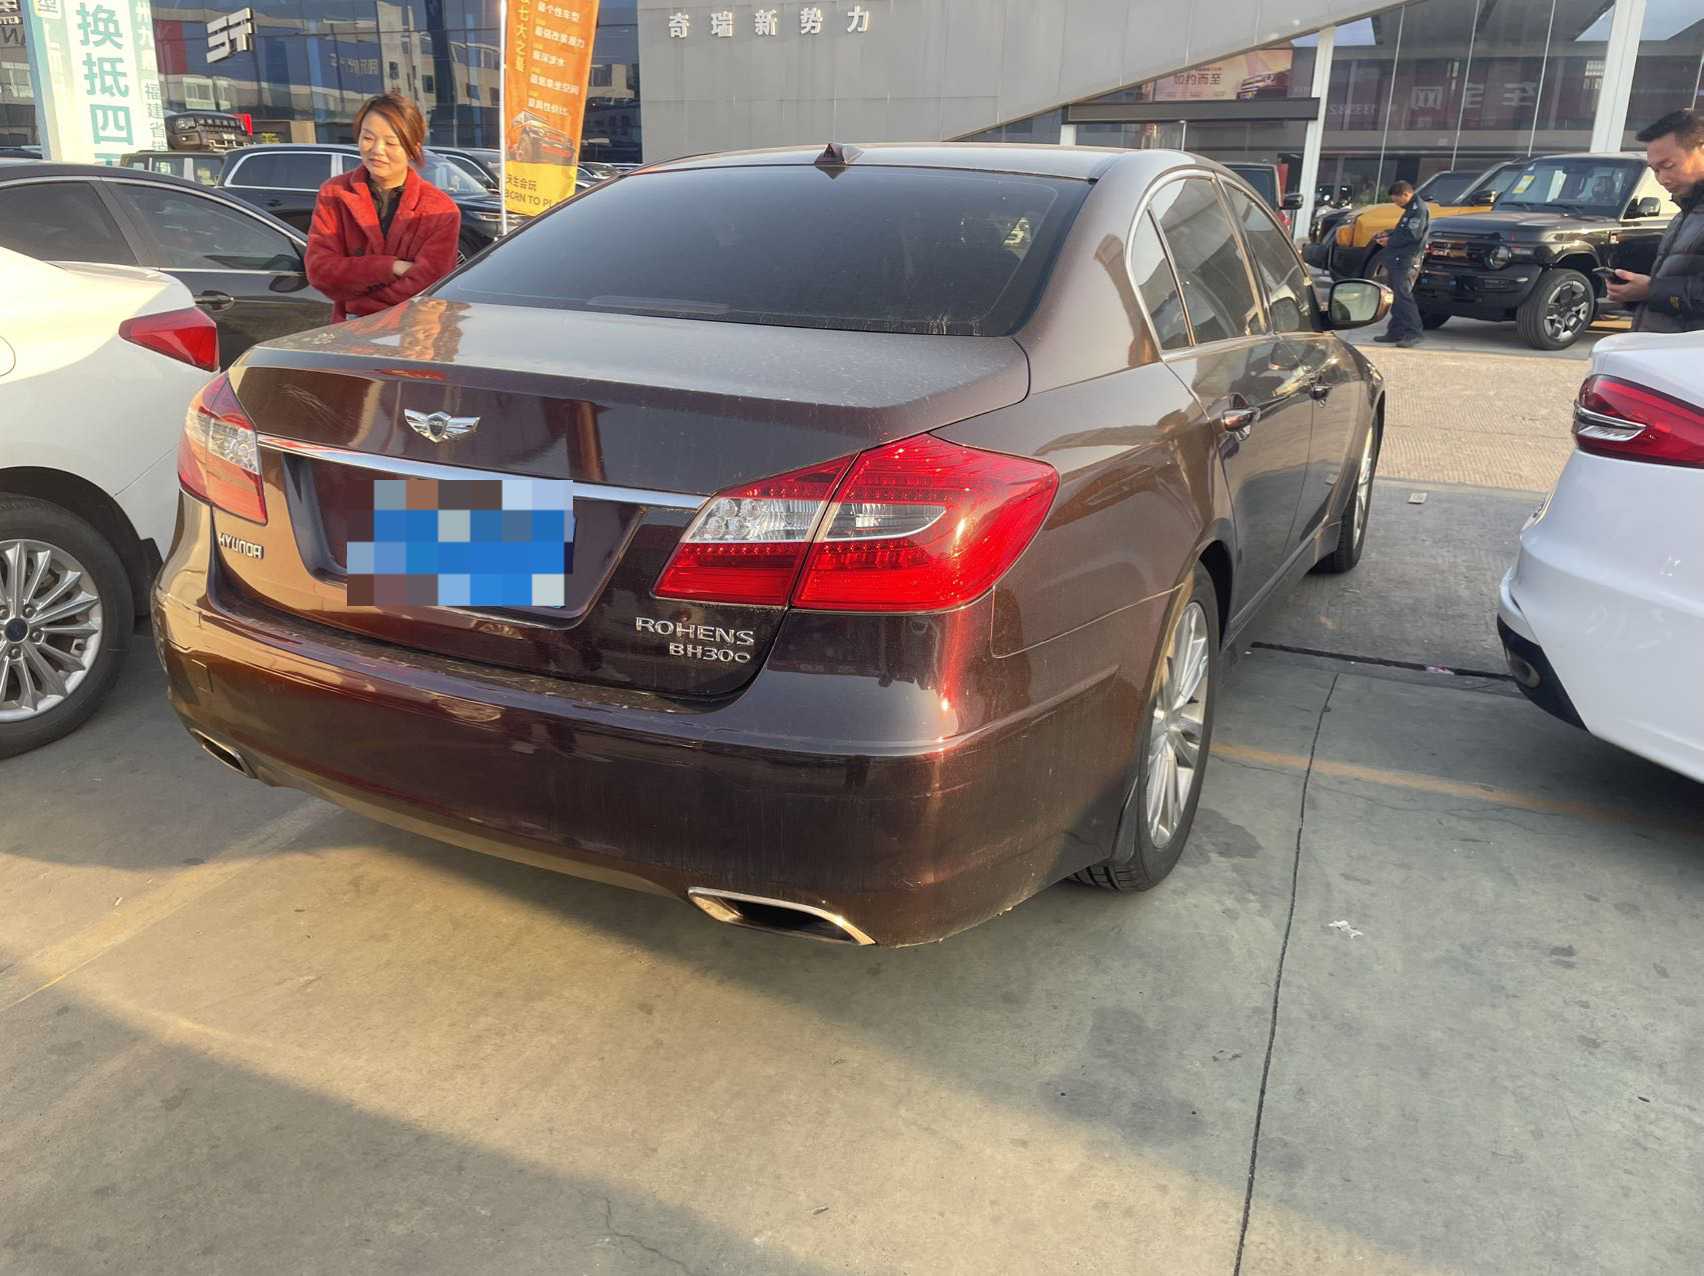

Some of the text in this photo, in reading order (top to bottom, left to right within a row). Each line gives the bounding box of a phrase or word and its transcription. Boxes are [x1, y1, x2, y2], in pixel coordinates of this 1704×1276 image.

[514, 0, 530, 73] 七大之最
[668, 6, 870, 38] 奇瑞新势力
[527, 195, 541, 205] TO
[635, 616, 755, 646] ROHENS
[669, 642, 751, 664] BH300
